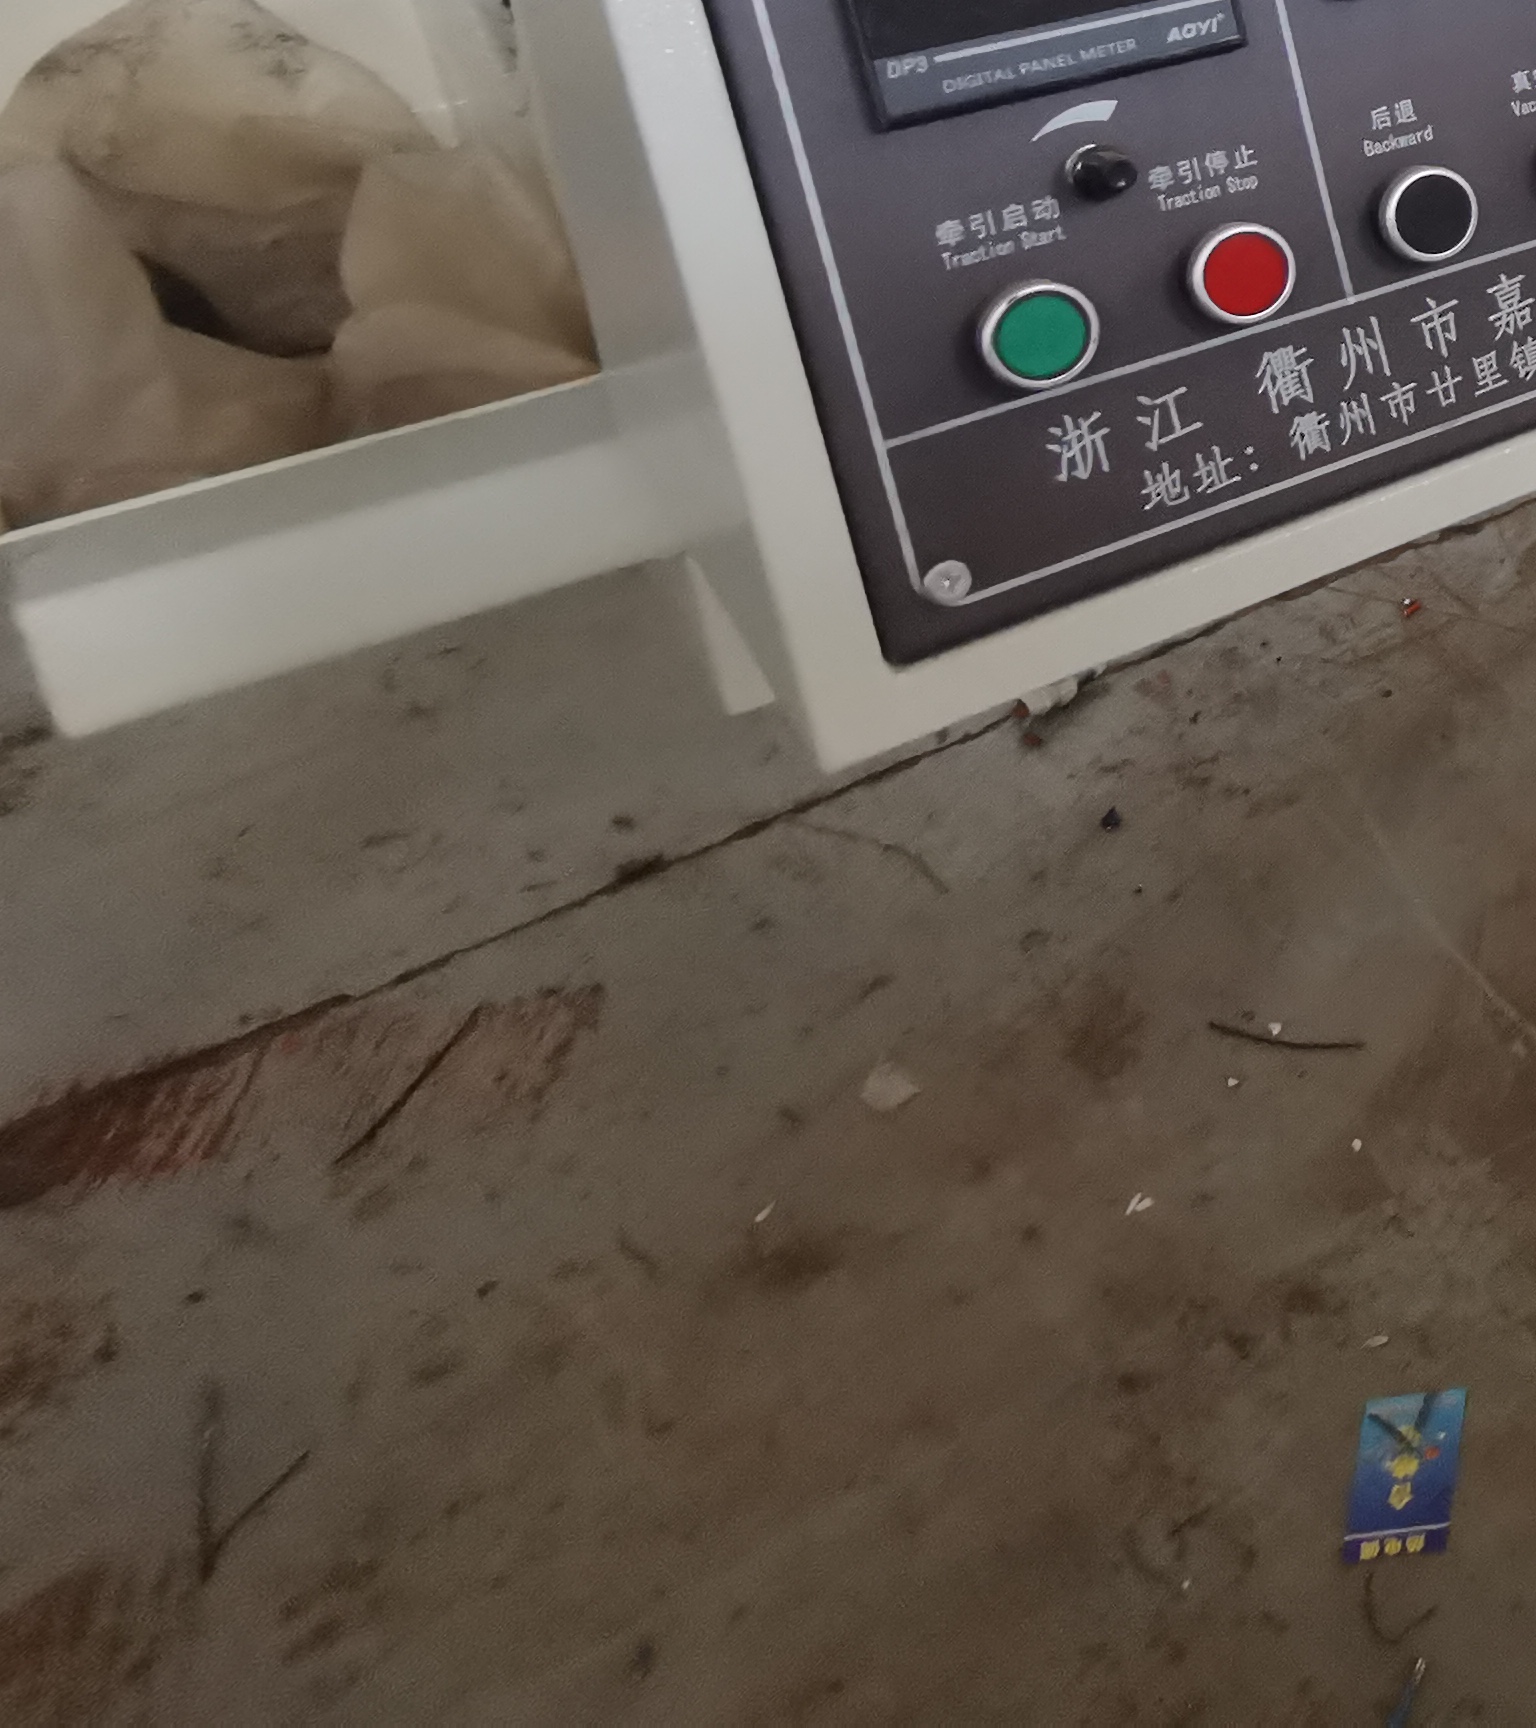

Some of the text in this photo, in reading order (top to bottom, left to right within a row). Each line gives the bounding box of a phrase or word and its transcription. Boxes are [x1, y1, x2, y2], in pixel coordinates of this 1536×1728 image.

[942, 68, 1016, 94] DIGITAL
[1018, 52, 1078, 75] PANEL
[1079, 38, 1137, 62] METER
[1370, 99, 1418, 131] 后退
[1363, 124, 1434, 157] Backward
[1147, 144, 1258, 192] 牵引停止
[1156, 174, 1258, 212] Traction Stop
[935, 194, 1060, 247] 牵引启动
[941, 224, 1066, 270] Traction Start
